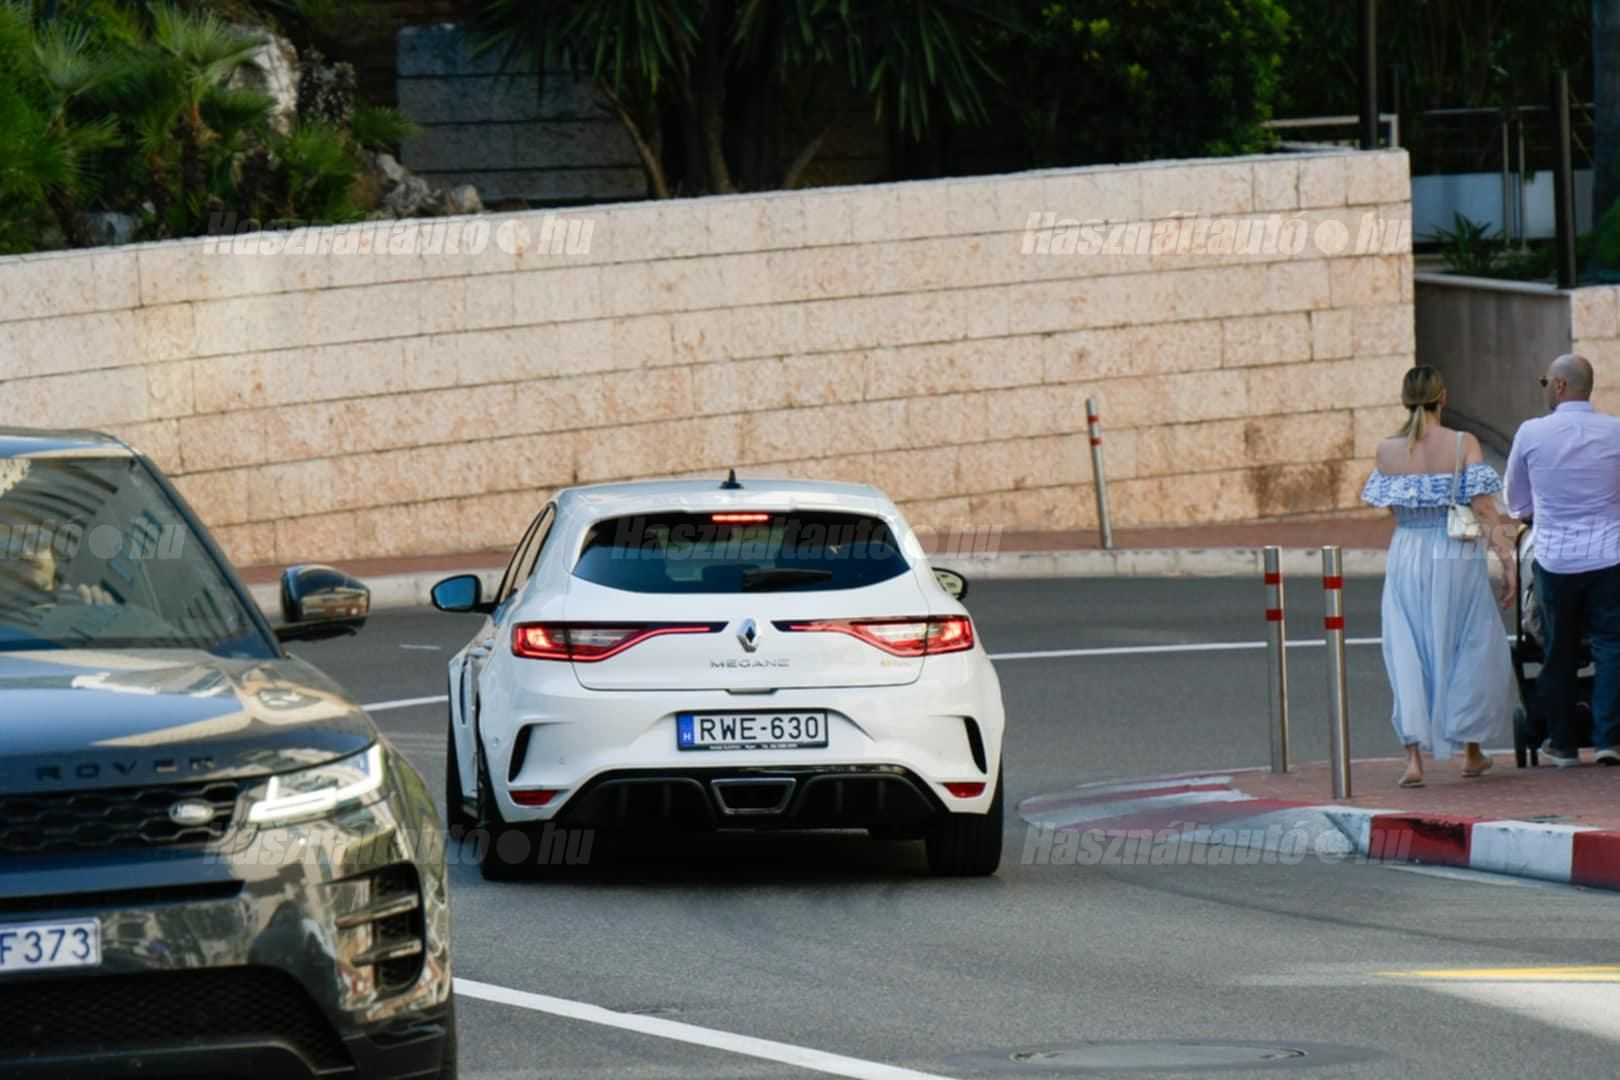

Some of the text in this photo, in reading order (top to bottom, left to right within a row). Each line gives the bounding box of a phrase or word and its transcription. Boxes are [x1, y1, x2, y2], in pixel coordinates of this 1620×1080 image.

[700, 716, 819, 741] RWE-630
[35, 757, 217, 781] ROVER
[0, 927, 90, 965] F373
